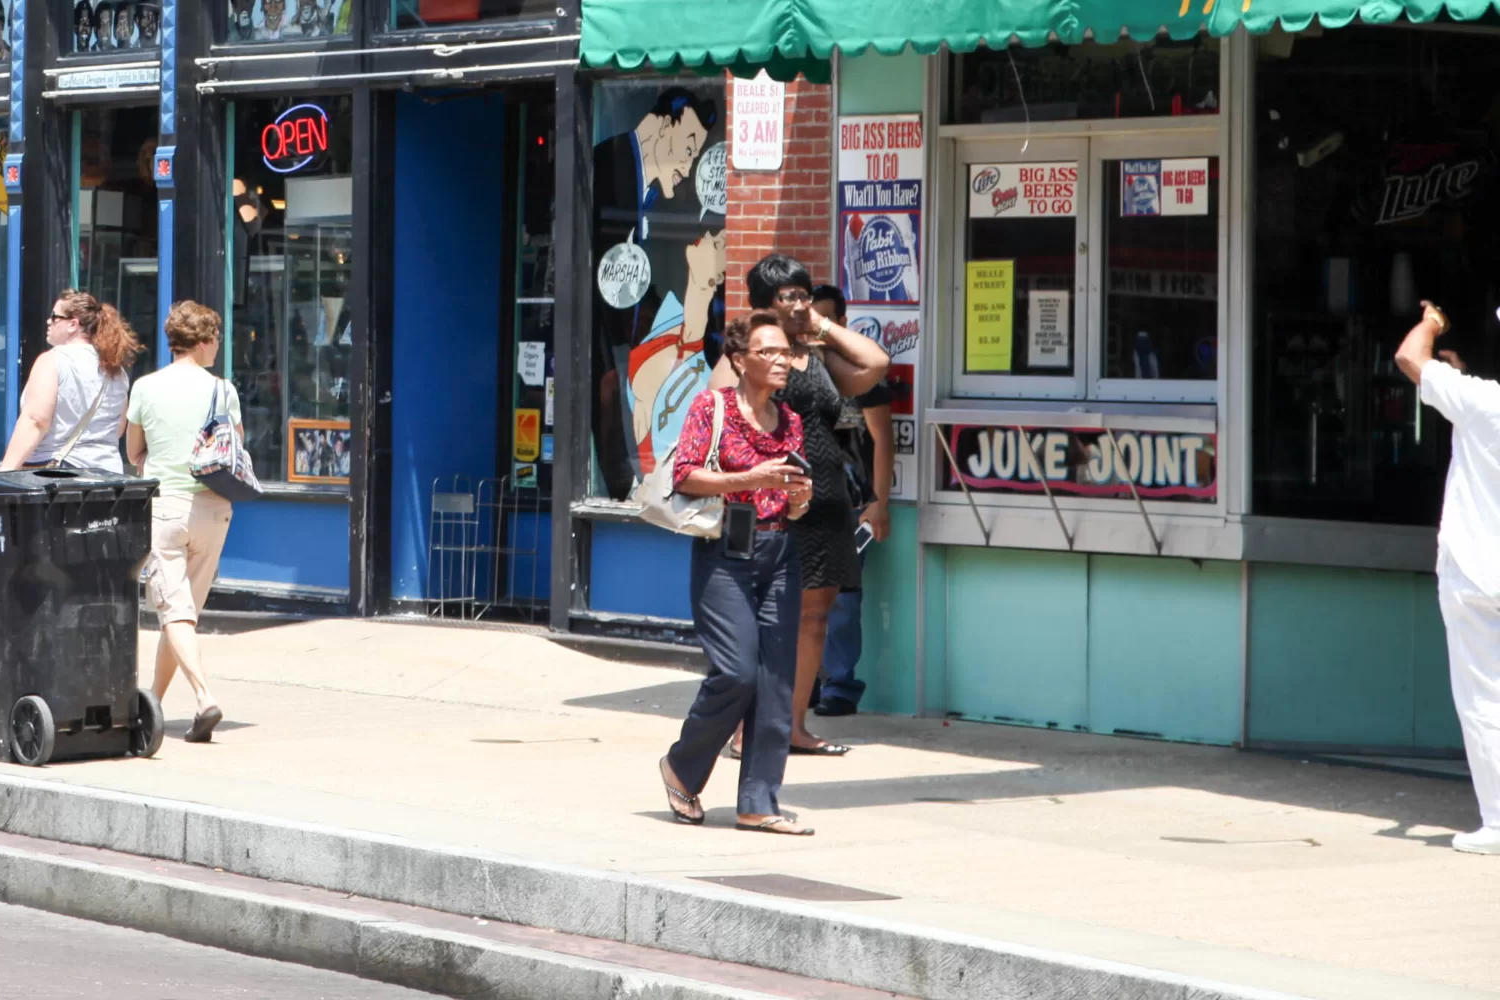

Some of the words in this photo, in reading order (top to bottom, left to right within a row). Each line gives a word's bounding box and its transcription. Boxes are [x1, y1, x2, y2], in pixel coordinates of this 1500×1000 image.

[737, 84, 765, 97] BEALE
[737, 101, 769, 115] CLEARED
[772, 101, 781, 115] AT
[262, 115, 327, 160] OPEN
[739, 120, 749, 143] 3
[753, 120, 778, 144] AM
[841, 124, 860, 150] BIG
[863, 123, 885, 150] ASS
[887, 121, 922, 149] BEERS
[866, 154, 880, 181] TO
[883, 153, 899, 181] GO
[1019, 168, 1045, 182] BIG
[1049, 167, 1078, 182] ASS
[702, 179, 711, 192] IT
[1174, 170, 1186, 186] ASS
[1187, 169, 1206, 186] BEERS
[844, 184, 874, 207] What'll
[876, 184, 891, 207] You
[893, 184, 919, 207] Have?
[1023, 183, 1074, 198] BEERS
[1176, 188, 1184, 204] TO
[1185, 187, 1193, 204] GO
[704, 195, 716, 206] THE
[1028, 200, 1048, 214] TO
[1051, 199, 1073, 214] GO
[864, 226, 896, 253] Pabst
[601, 260, 646, 282] MARSHA!
[855, 258, 877, 280] Blue
[876, 247, 912, 271] Ribbon
[976, 270, 1004, 278] BEALE
[974, 281, 1006, 289] STREET
[974, 303, 988, 311] BIG
[883, 319, 920, 347] Coors
[967, 430, 1070, 480] JUKE
[1089, 434, 1203, 488] JOINT
